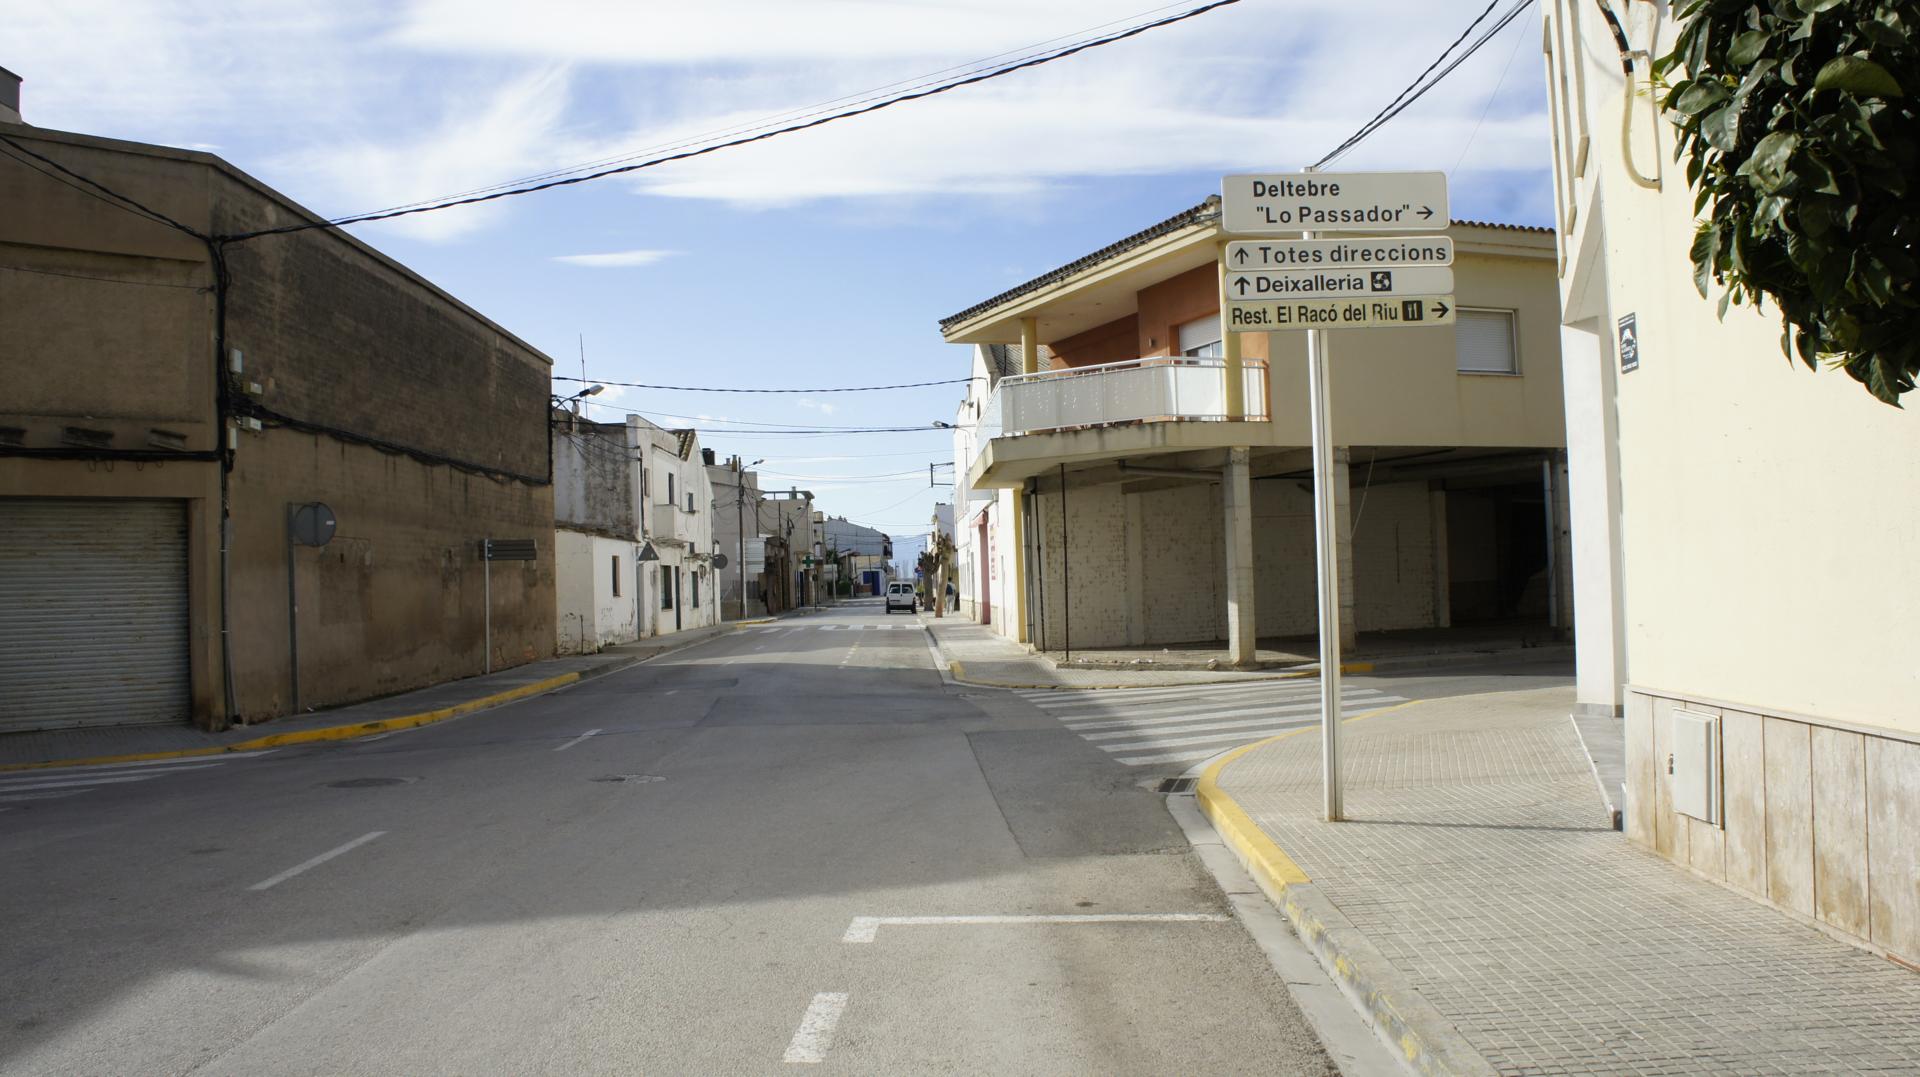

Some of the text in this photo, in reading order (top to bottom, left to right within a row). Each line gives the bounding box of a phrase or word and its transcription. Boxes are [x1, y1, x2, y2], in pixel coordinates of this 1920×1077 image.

[1253, 180, 1340, 198] Deltebre
[1256, 204, 1410, 224] "Lo Passador"
[1259, 244, 1446, 264] Totes direccions
[1256, 274, 1364, 293] Deixalleria
[1232, 303, 1398, 325] Rest. El Racó del Riu
